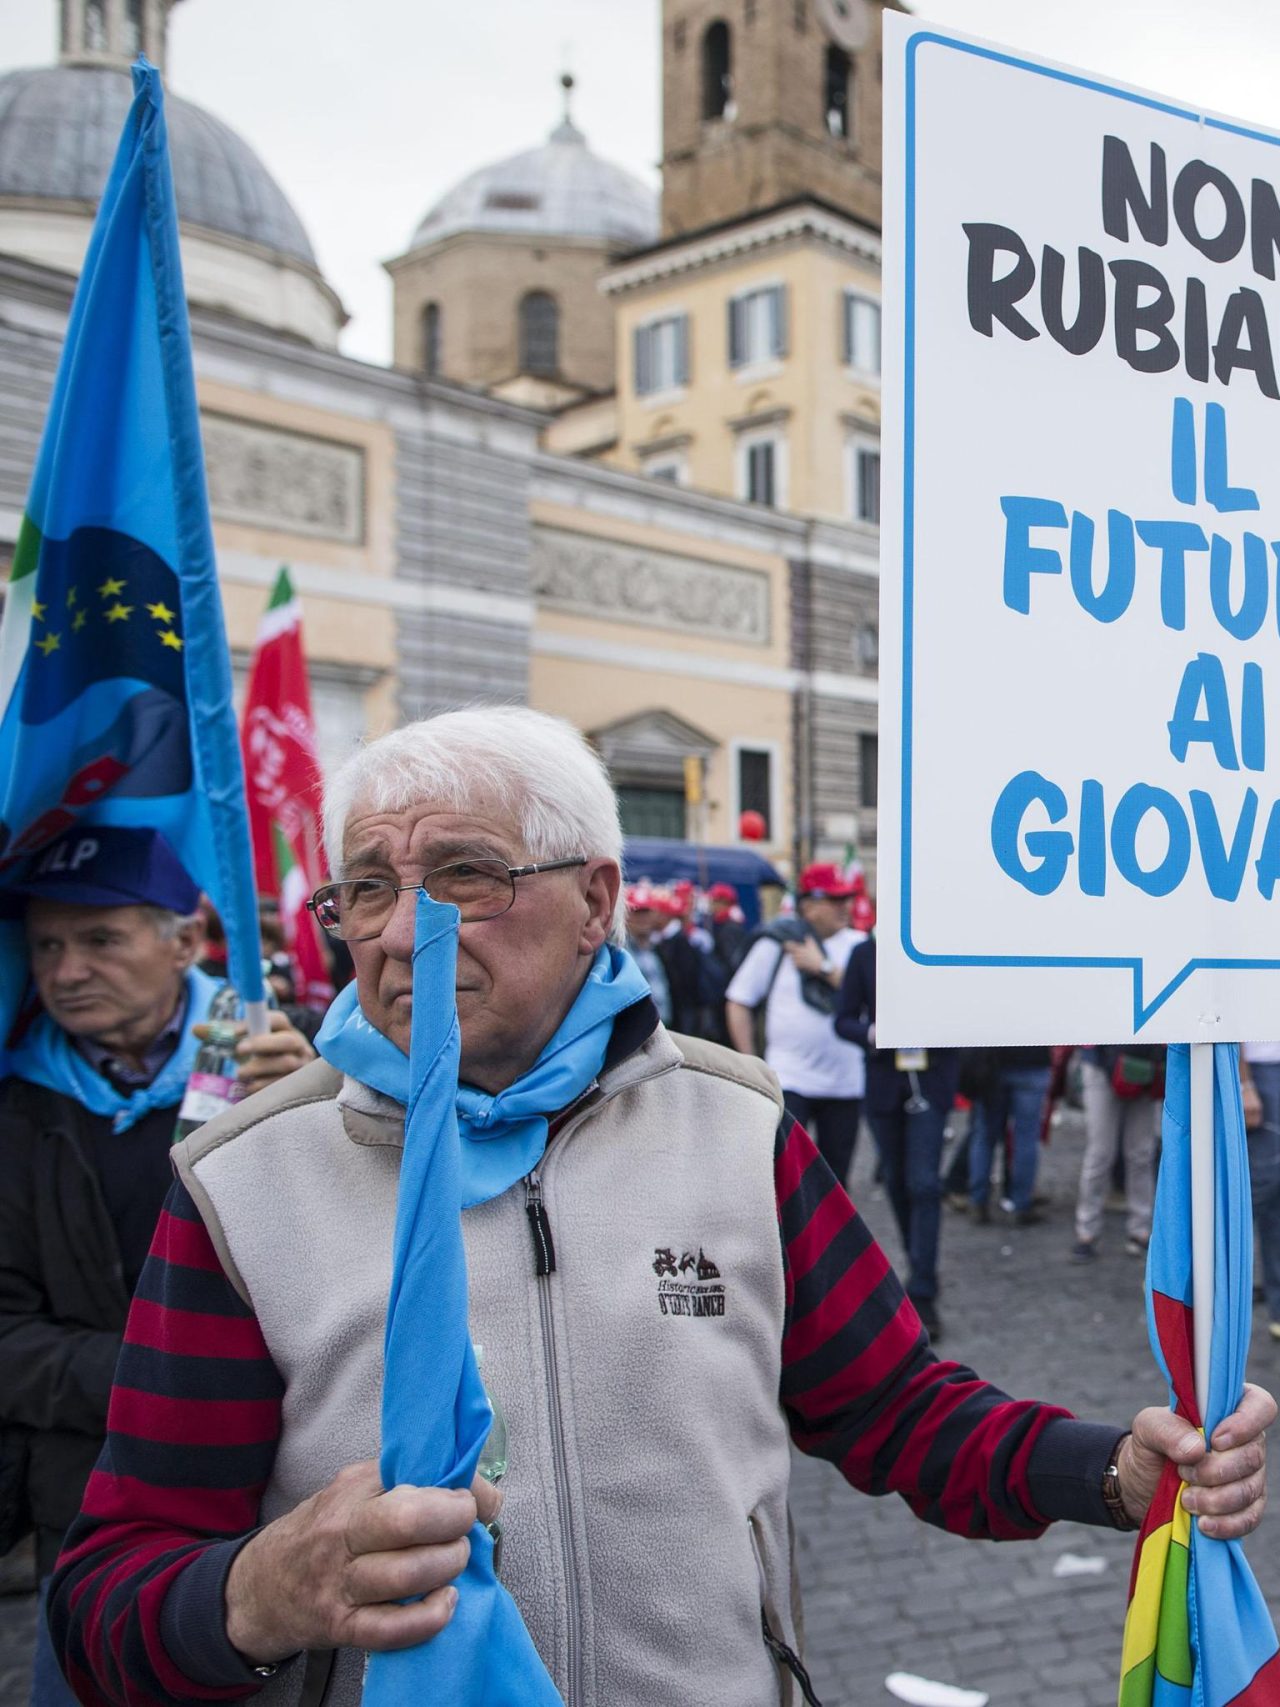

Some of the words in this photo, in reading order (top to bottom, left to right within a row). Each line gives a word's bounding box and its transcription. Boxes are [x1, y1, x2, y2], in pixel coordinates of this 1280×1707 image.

[1171, 396, 1261, 513] IL
[1167, 651, 1266, 772] AI
[691, 1294, 725, 1317] RANCH
